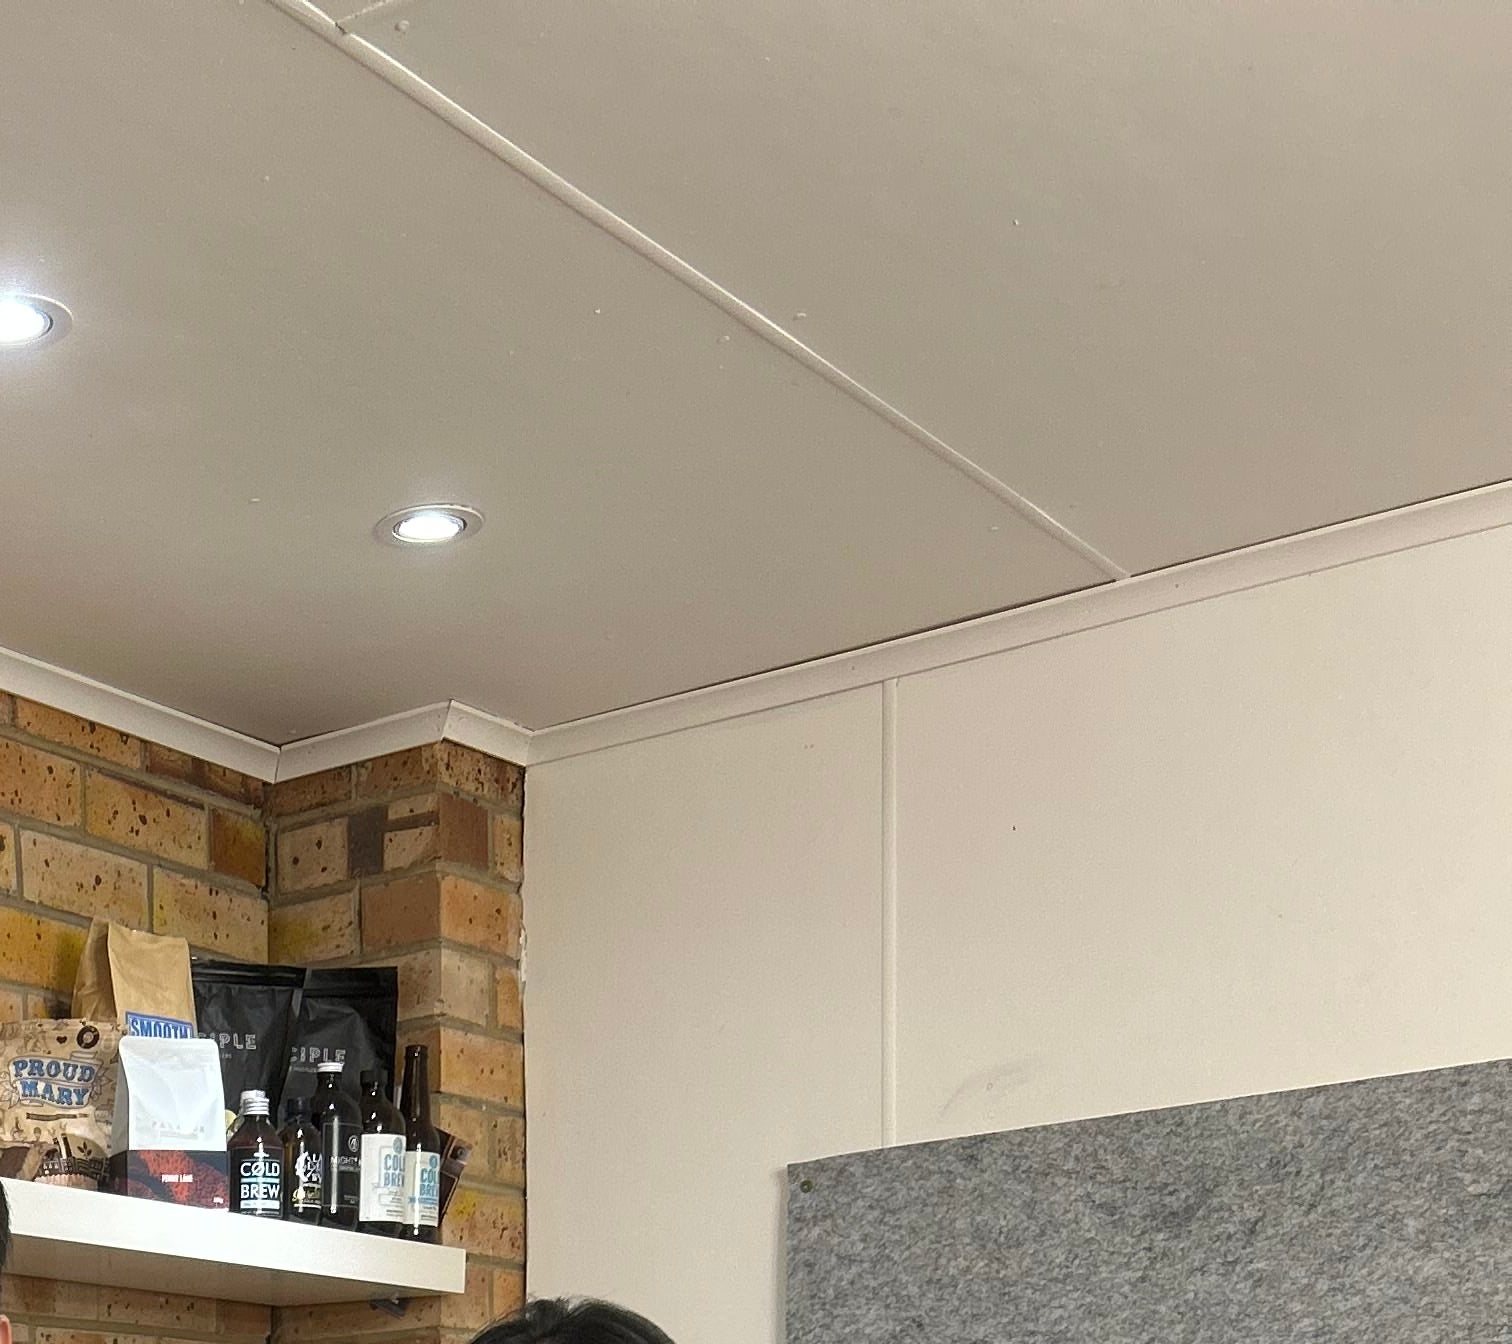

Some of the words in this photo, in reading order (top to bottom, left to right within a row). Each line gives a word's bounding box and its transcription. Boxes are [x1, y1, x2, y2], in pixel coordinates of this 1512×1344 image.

[131, 1017, 187, 1039] SMOOTH
[12, 1059, 96, 1082] PROUD
[20, 1080, 89, 1106] MARY
[384, 1154, 405, 1172] COL
[420, 1168, 439, 1183] COL
[240, 1184, 280, 1199] BREW
